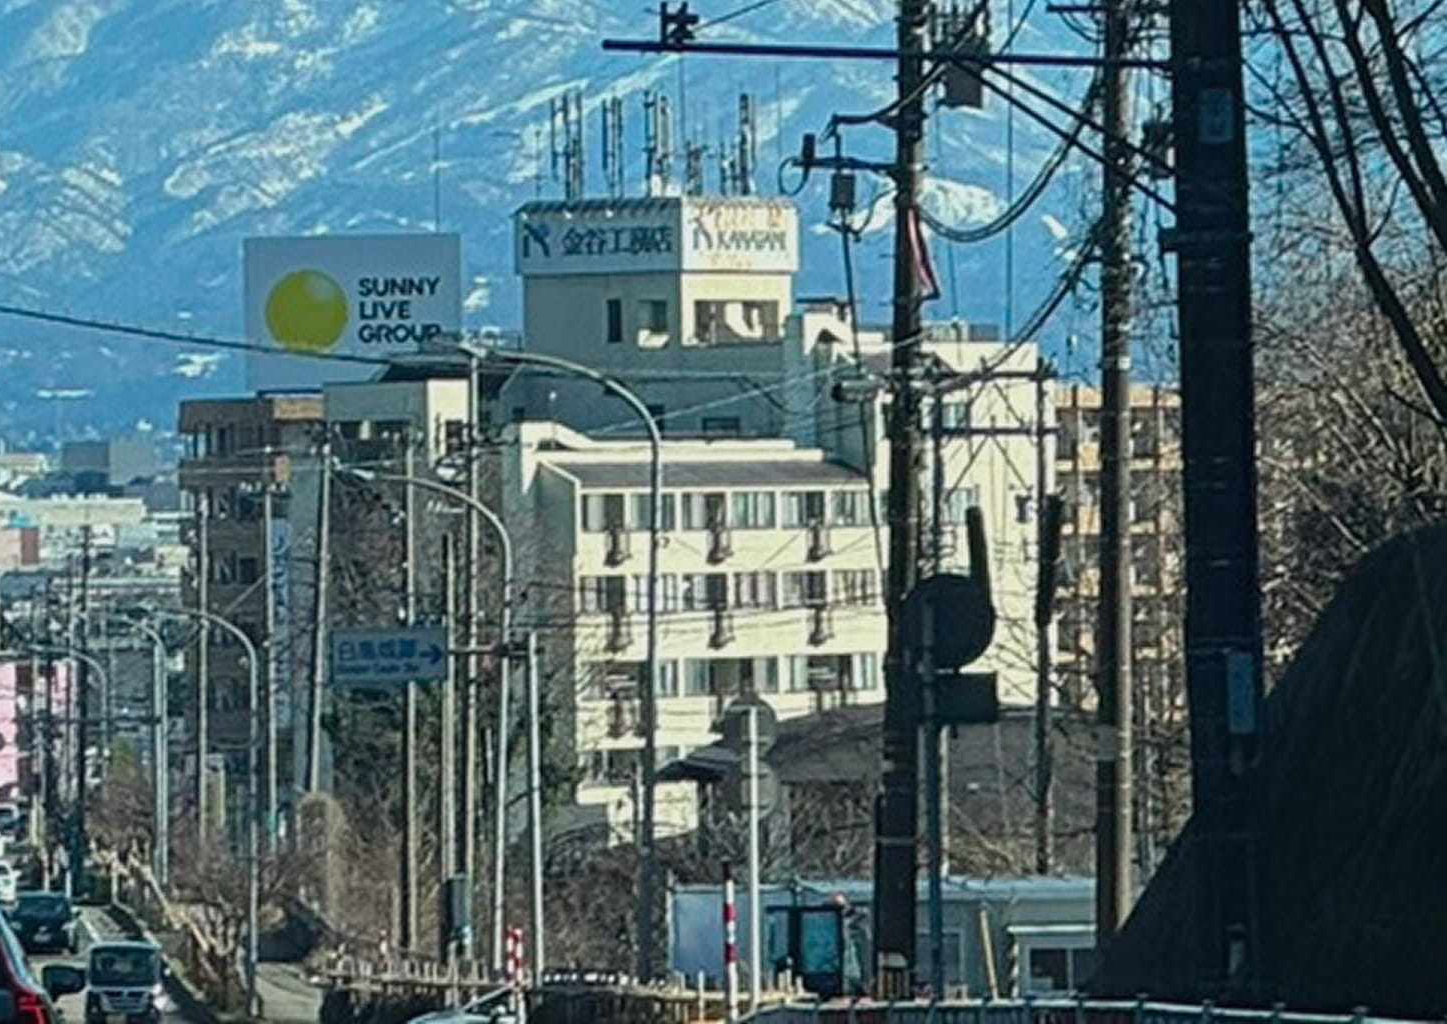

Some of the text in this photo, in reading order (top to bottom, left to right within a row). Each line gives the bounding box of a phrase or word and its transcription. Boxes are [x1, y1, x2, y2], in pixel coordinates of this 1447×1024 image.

[358, 277, 441, 297] SUNNY
[359, 300, 411, 320] LIVE
[358, 323, 441, 344] GROUP
